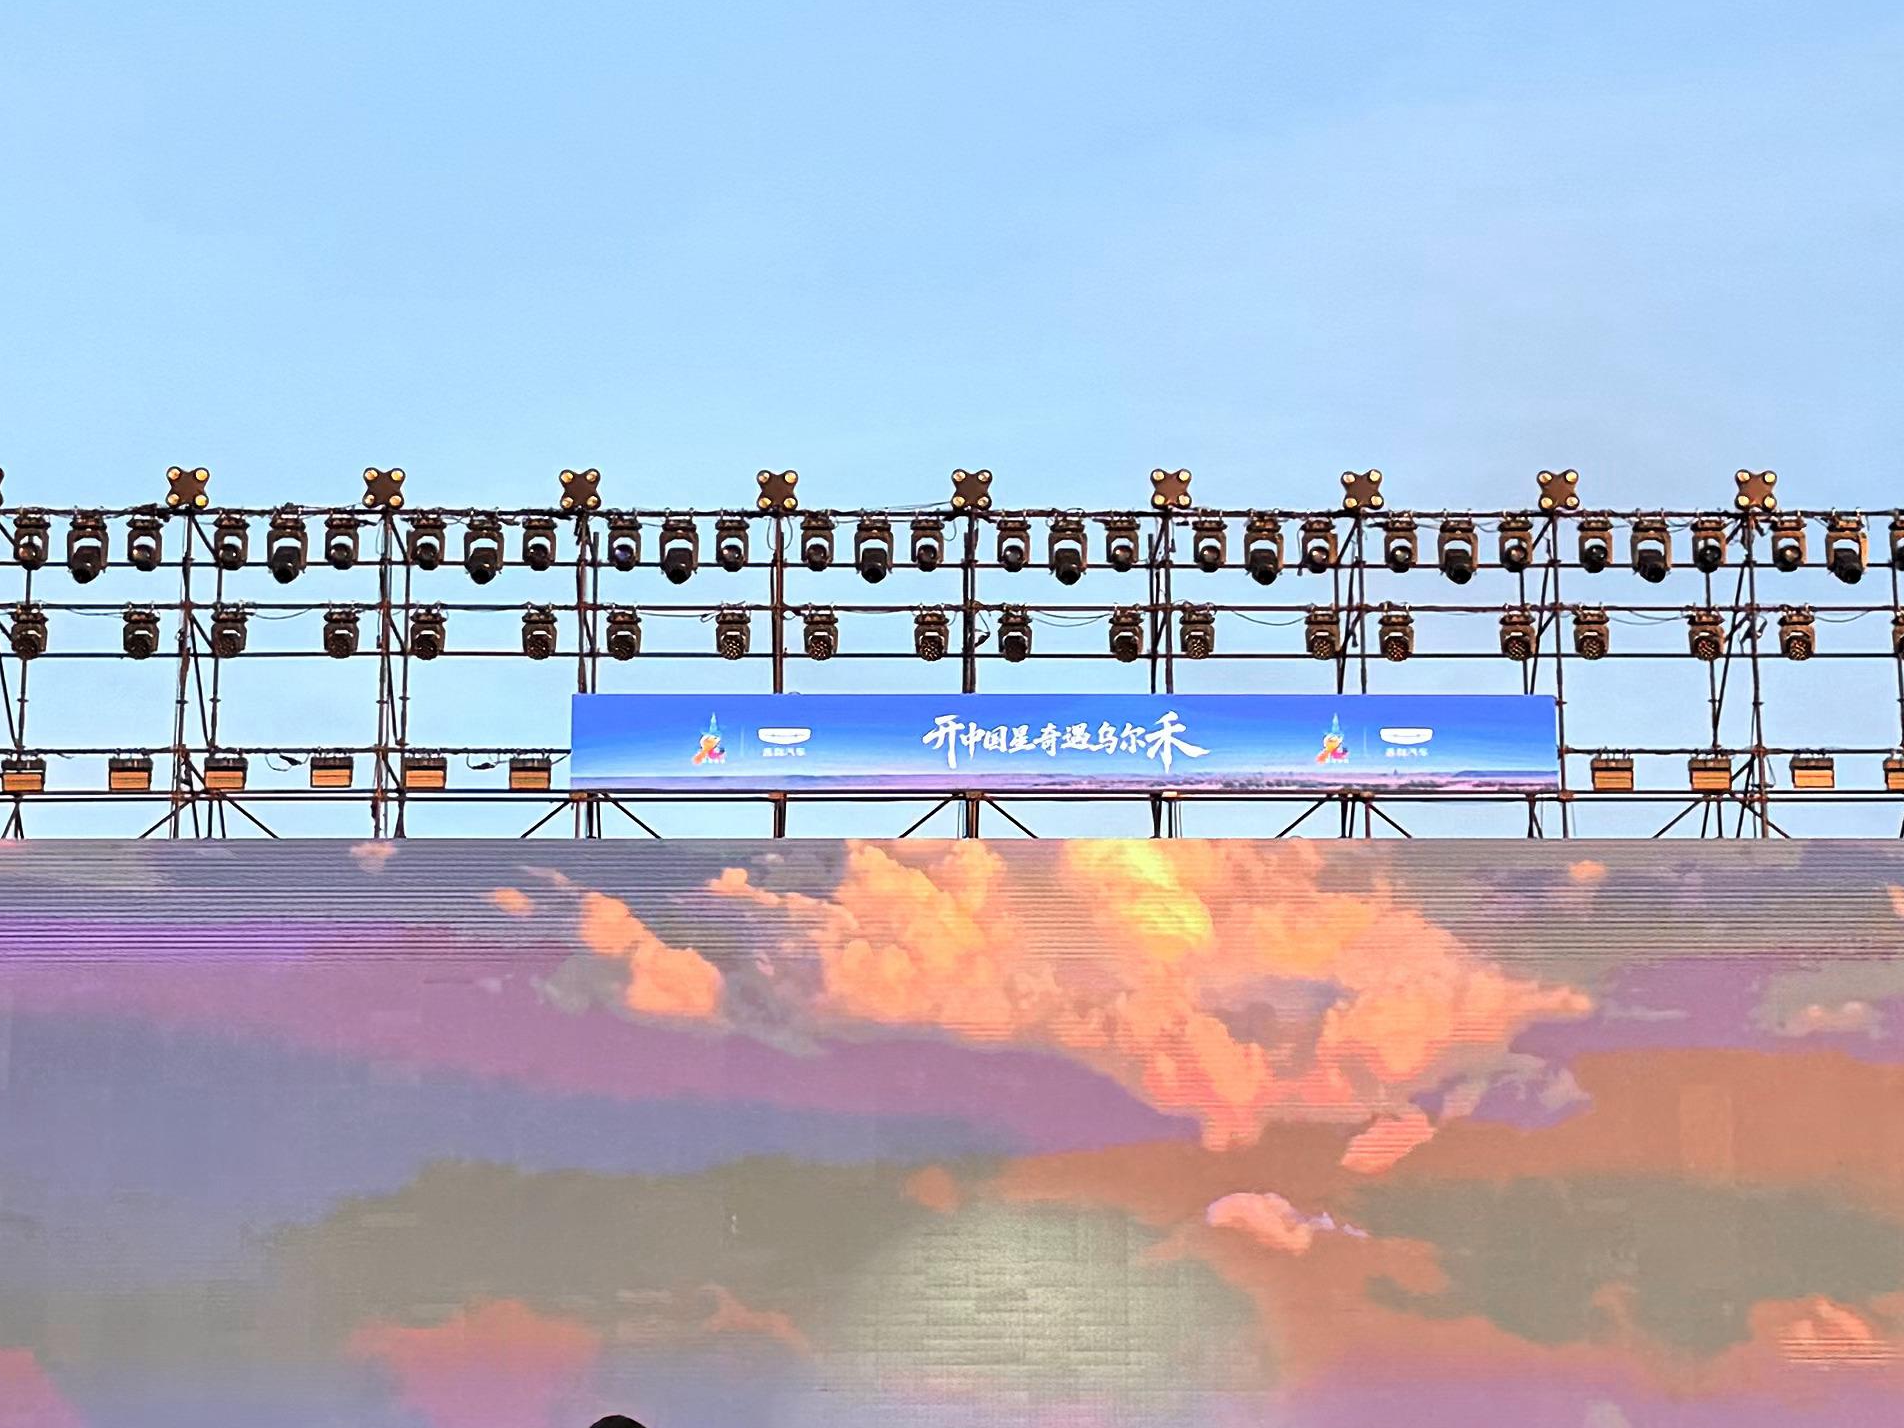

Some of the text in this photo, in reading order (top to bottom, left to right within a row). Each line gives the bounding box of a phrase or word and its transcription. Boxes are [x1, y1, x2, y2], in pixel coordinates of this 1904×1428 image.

[922, 710, 1211, 774] 开中国星奇遇乌尔禾
